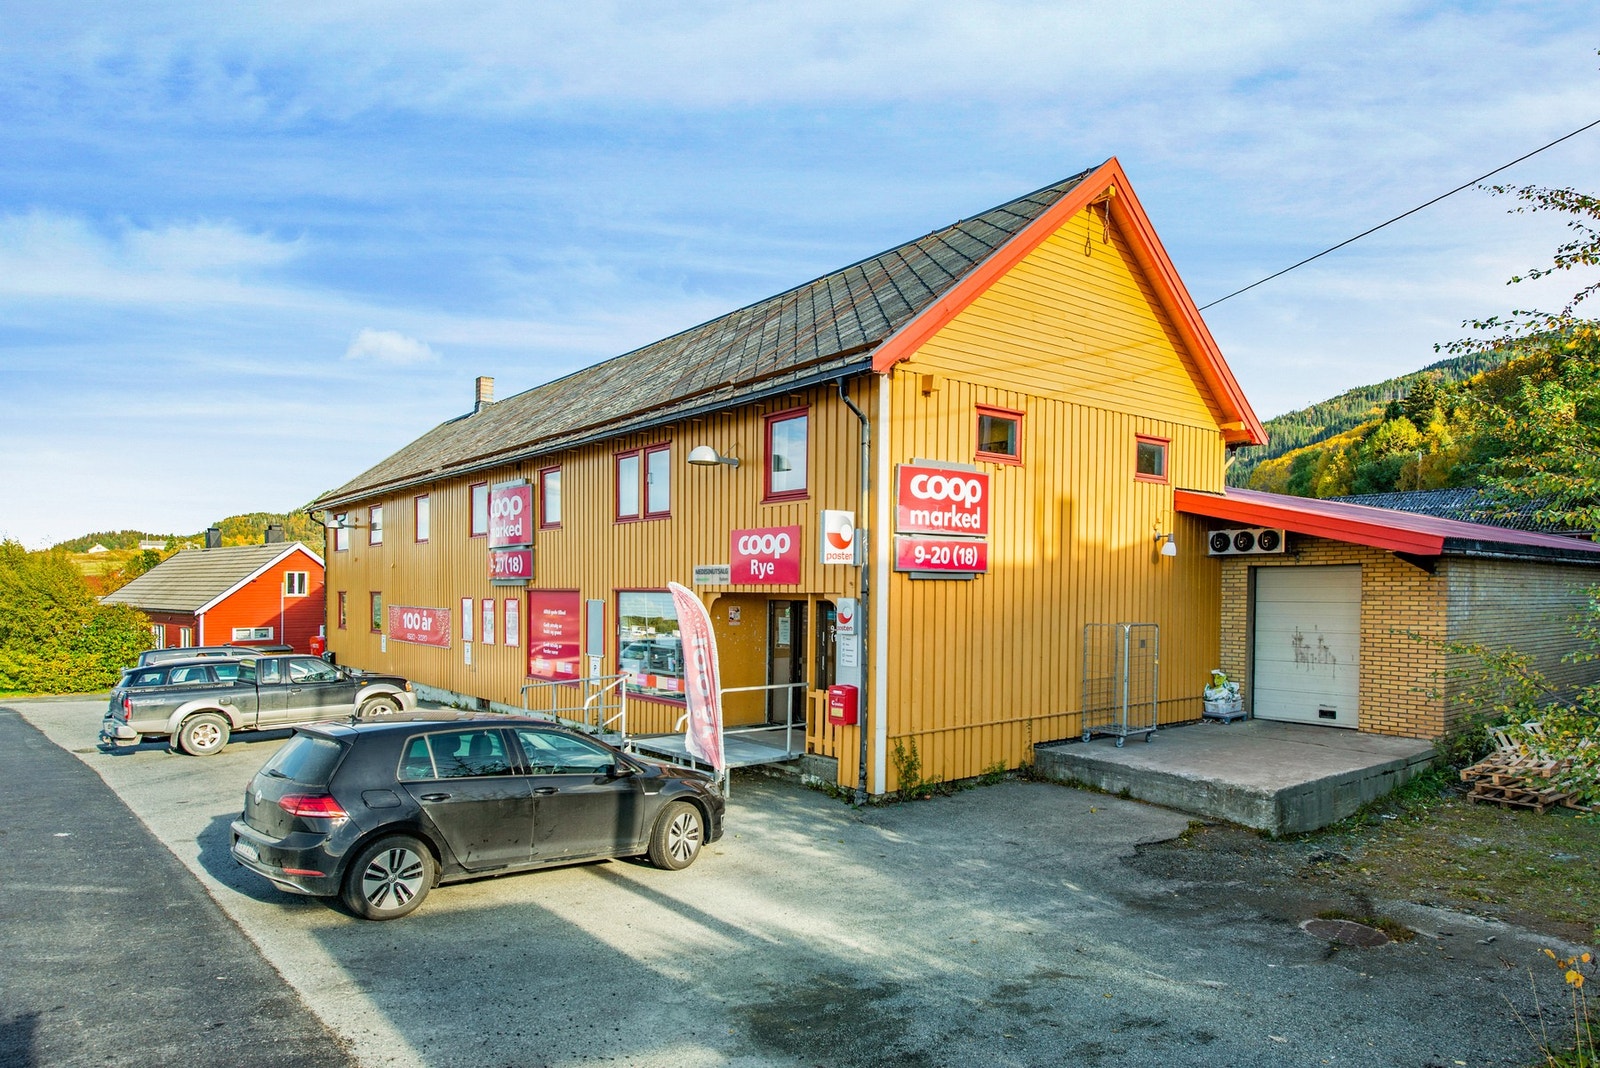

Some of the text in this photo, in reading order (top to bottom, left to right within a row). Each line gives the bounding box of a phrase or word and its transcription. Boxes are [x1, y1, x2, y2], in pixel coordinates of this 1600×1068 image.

[909, 474, 982, 508] coop
[910, 504, 981, 529] marked
[738, 532, 791, 559] coop
[826, 551, 853, 561] posten
[914, 545, 978, 567] 9-20 (18)
[505, 554, 523, 574] (18)
[750, 559, 775, 580] Rye
[402, 610, 433, 631] 100 år
